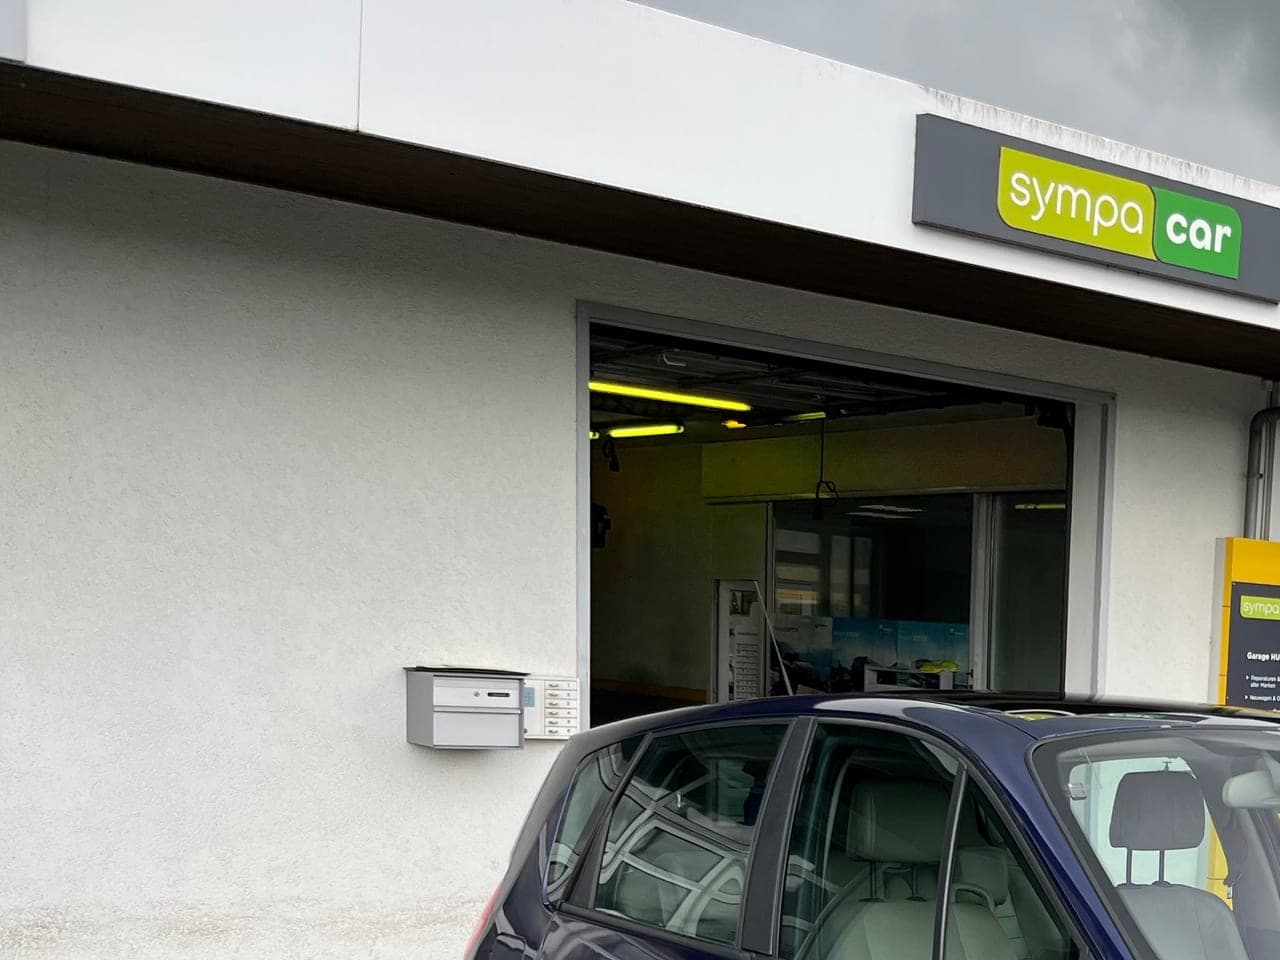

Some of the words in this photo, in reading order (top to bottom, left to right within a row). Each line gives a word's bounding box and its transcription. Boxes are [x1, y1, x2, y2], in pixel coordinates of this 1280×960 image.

[1009, 170, 1144, 236] sympa
[1165, 211, 1233, 254] car
[1243, 602, 1280, 616] sympa
[1246, 651, 1270, 662] Garage
